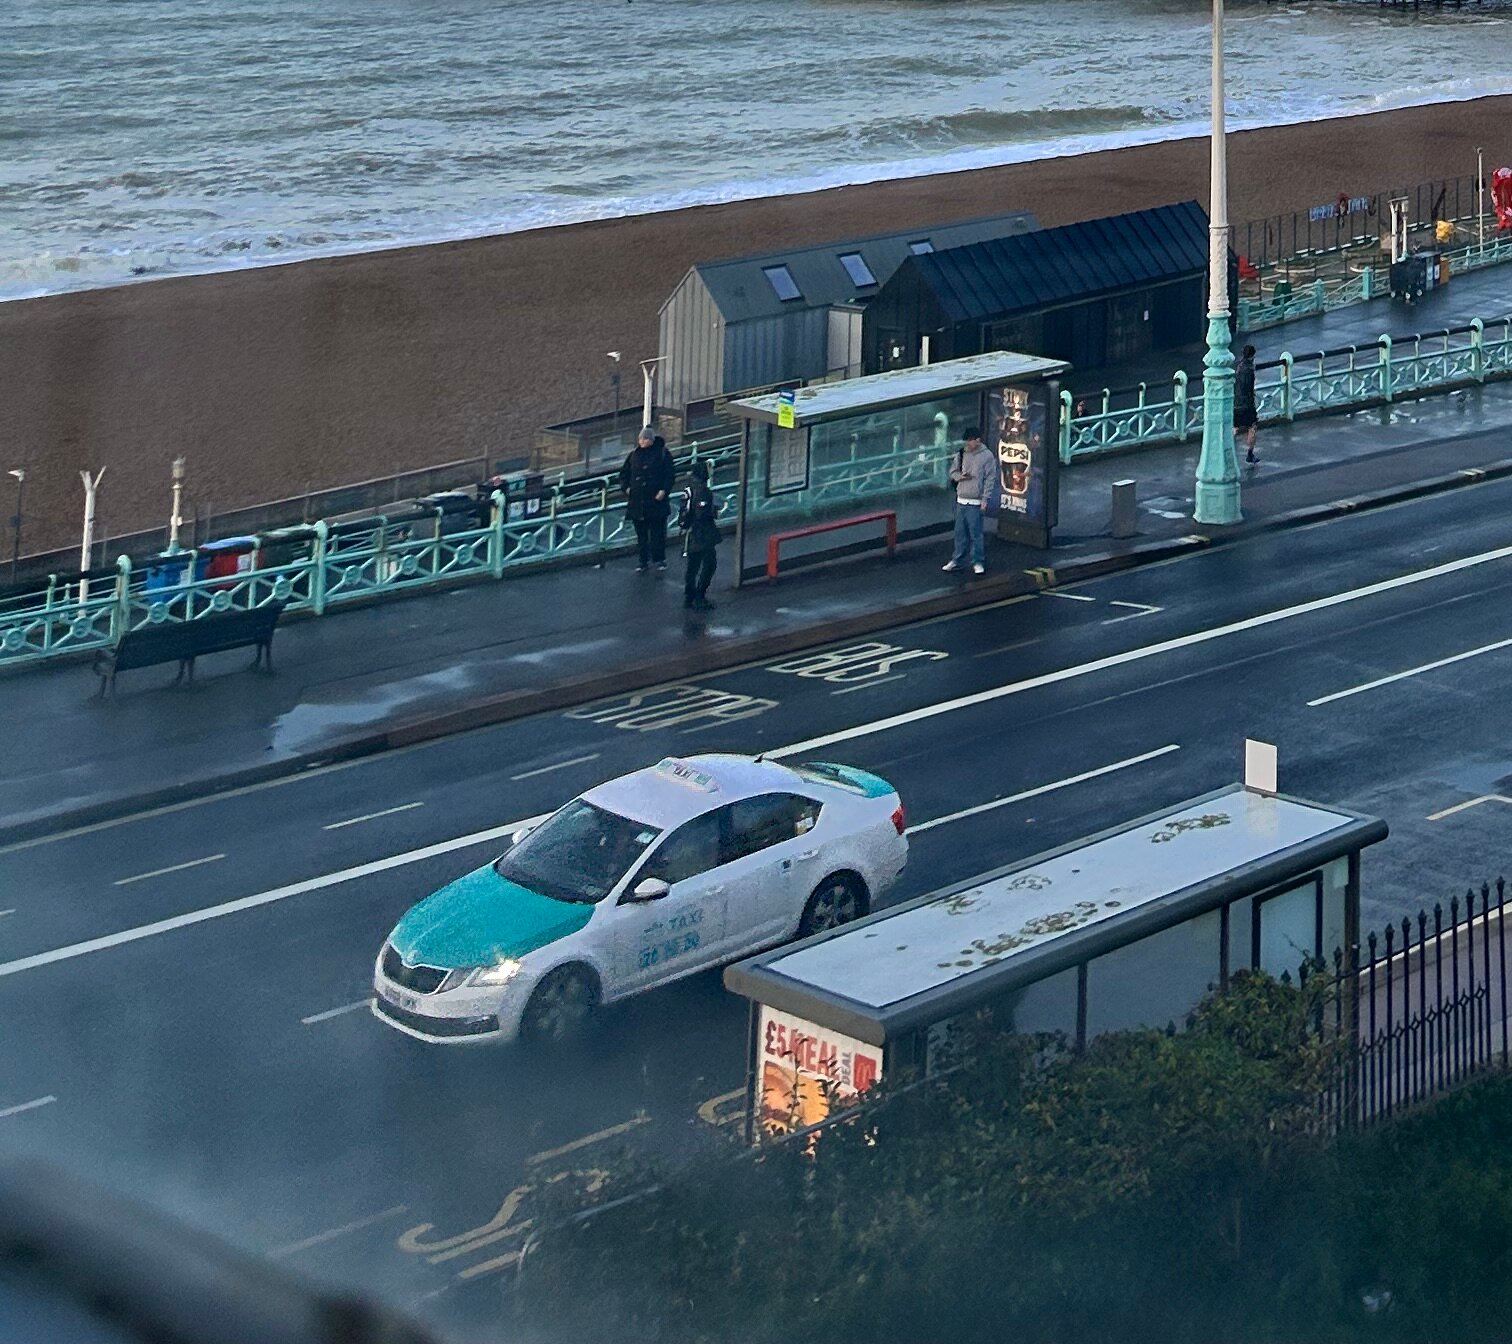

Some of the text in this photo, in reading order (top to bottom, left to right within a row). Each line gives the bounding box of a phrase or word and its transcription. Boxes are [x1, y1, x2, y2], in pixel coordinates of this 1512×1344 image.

[1000, 445, 1029, 461] PEPSI
[764, 642, 950, 683] BUS
[560, 684, 781, 734] STOP
[842, 1052, 857, 1086] DEAL
